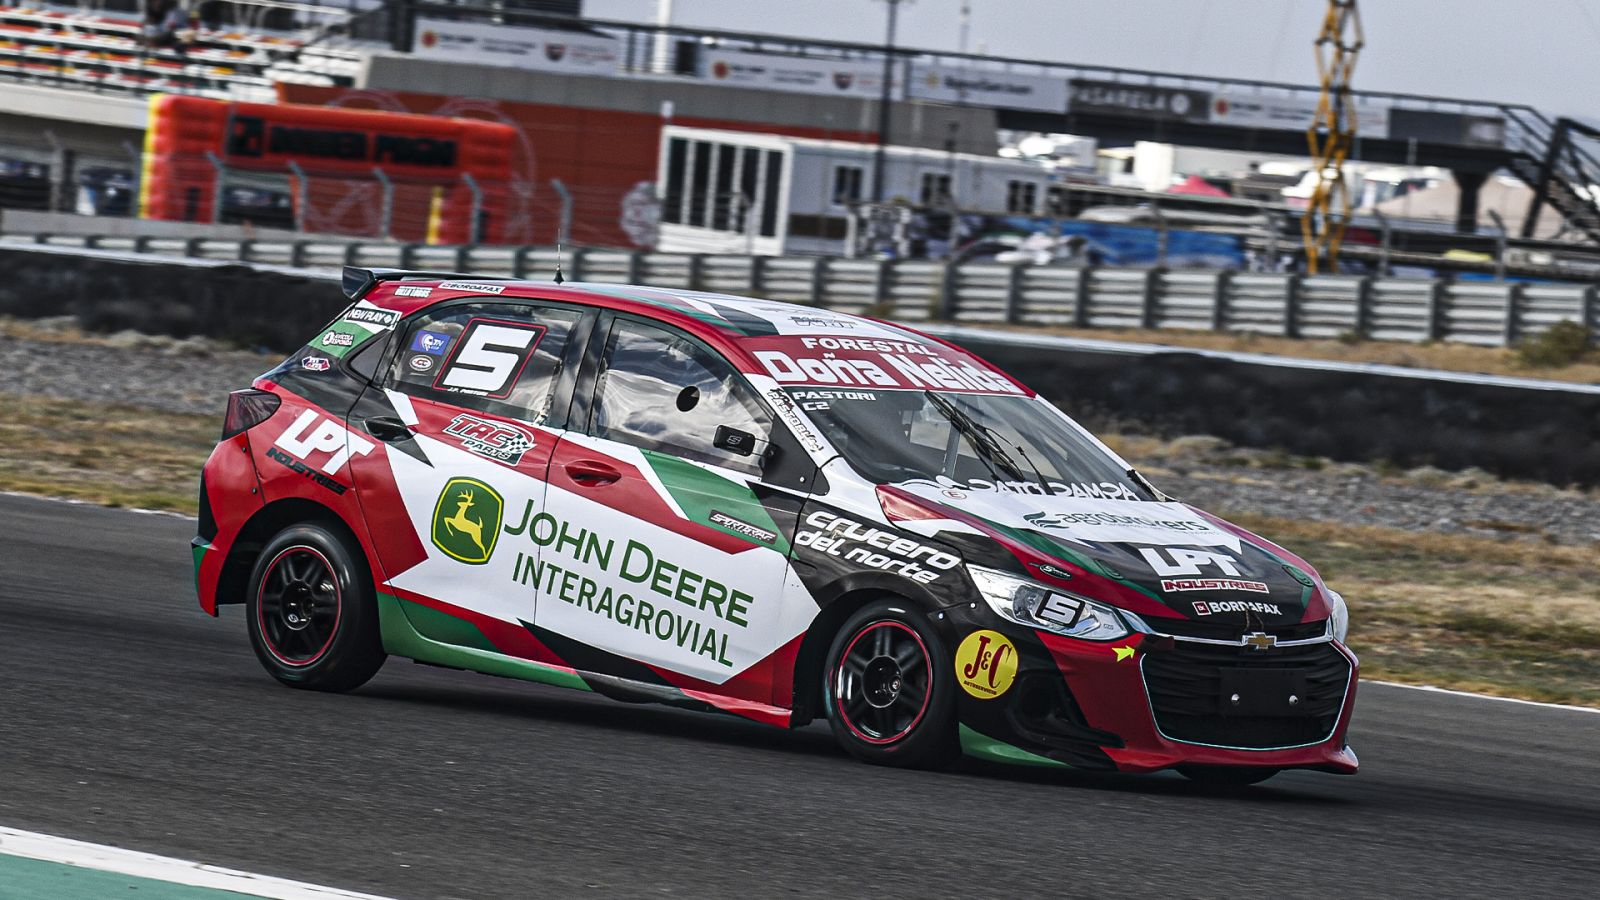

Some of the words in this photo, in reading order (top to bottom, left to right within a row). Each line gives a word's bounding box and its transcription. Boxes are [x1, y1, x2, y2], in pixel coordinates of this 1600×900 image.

[364, 311, 385, 323] PLAY
[442, 324, 536, 391] 5
[800, 337, 938, 356] FORESTAL
[753, 351, 901, 386] Doña
[791, 391, 877, 401] PASTORI
[801, 401, 831, 411] C2
[273, 407, 377, 476] LPT
[463, 439, 512, 460] PARTS
[266, 447, 349, 496] INDUSTRIES
[503, 498, 615, 571] JOHN
[619, 538, 754, 628] DEERE
[794, 530, 846, 556] del
[843, 547, 941, 584] norte
[1138, 547, 1242, 577] LPT
[1163, 580, 1268, 593] INDUSTRIES
[512, 551, 734, 668] INTERAGROVIAL
[1040, 593, 1081, 624] 5
[1209, 601, 1283, 616] BORDAFAX
